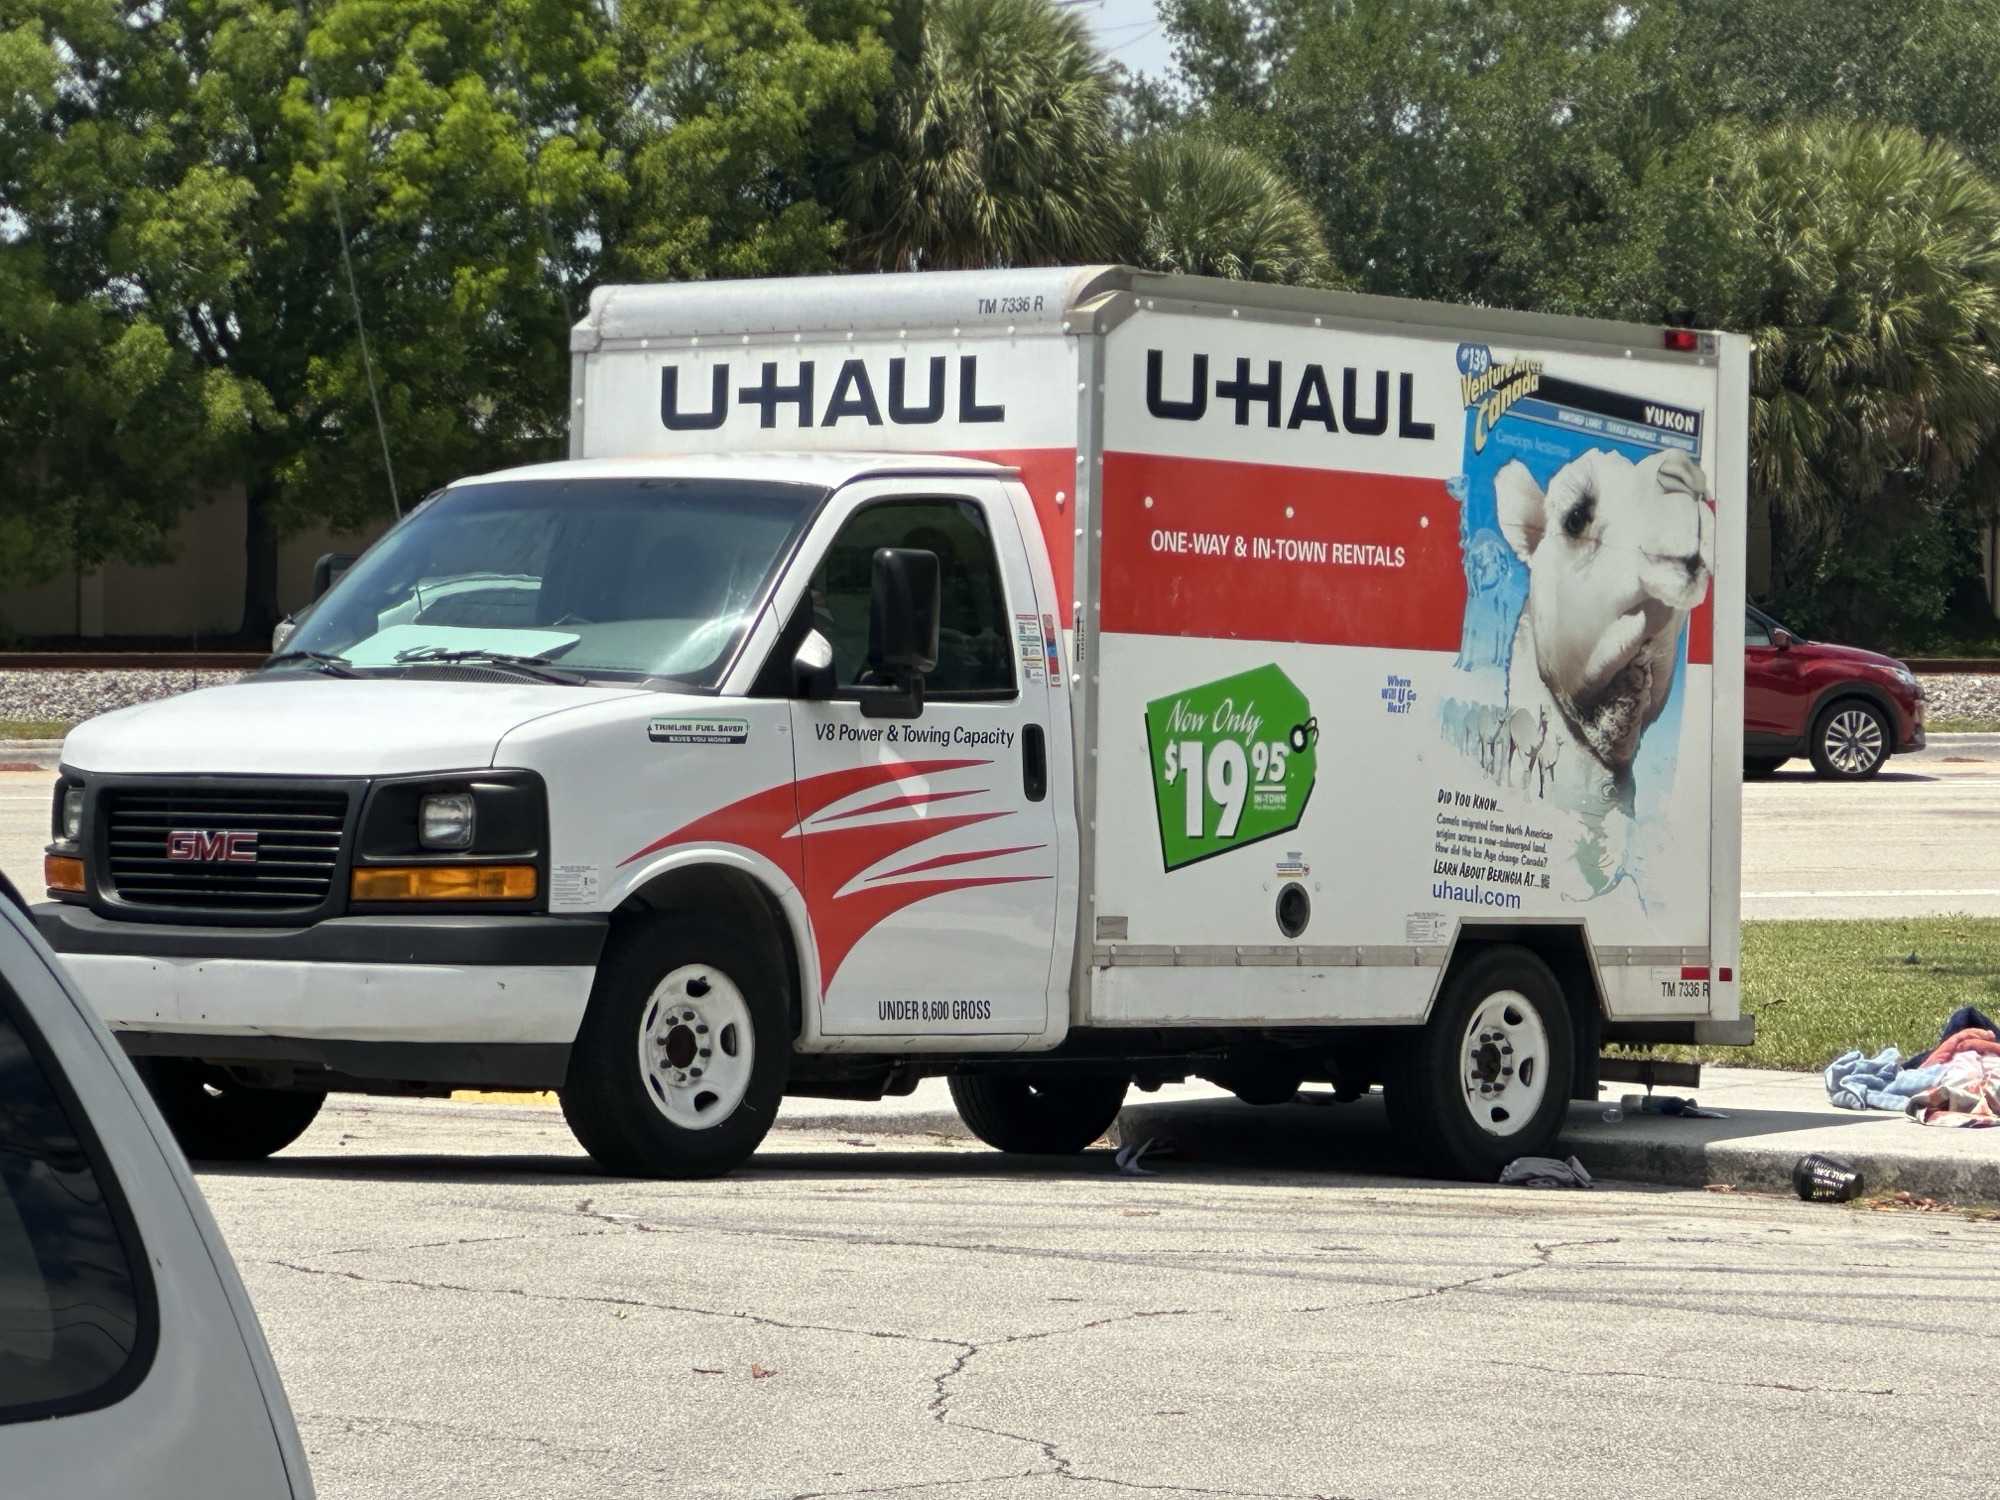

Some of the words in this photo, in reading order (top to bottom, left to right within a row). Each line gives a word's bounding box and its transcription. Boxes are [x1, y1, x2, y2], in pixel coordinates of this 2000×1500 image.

[978, 299, 997, 314] TM
[1001, 296, 1031, 313] 7336
[1034, 295, 1044, 312] R
[1461, 362, 1514, 411] Venture
[1474, 373, 1540, 454] Canada
[1645, 405, 1696, 433] YUKON
[1150, 529, 1231, 556] ONE-WAY
[1233, 535, 1248, 558] &
[1252, 537, 1328, 563] IN-TOWN
[1331, 543, 1406, 568] RENTALS
[696, 724, 715, 732] FUEL
[718, 724, 744, 732] SAVER
[1165, 699, 1208, 734] Now
[1212, 698, 1265, 746] Only
[815, 723, 836, 741] V8
[839, 724, 883, 742] Power
[887, 724, 899, 743] &
[902, 725, 951, 747] Towing
[954, 726, 1015, 749] Capacity
[1436, 812, 1460, 826] Camels
[1461, 817, 1489, 832] migrated
[1490, 820, 1504, 832] from
[1506, 823, 1523, 836] North
[1458, 832, 1477, 843] across
[167, 831, 258, 862] GMC
[1435, 841, 1449, 854] How
[1450, 845, 1460, 856] did
[1462, 846, 1472, 858] the
[1484, 849, 1497, 862] Age
[1498, 853, 1520, 866] change
[1521, 854, 1549, 868] Canada?
[1433, 880, 1521, 910] uhaul.com
[1662, 982, 1676, 997] TM
[1678, 982, 1699, 997] 7336
[878, 1000, 919, 1020] UNDER
[922, 1001, 949, 1022] 8,600
[952, 1000, 991, 1020] GROSS
